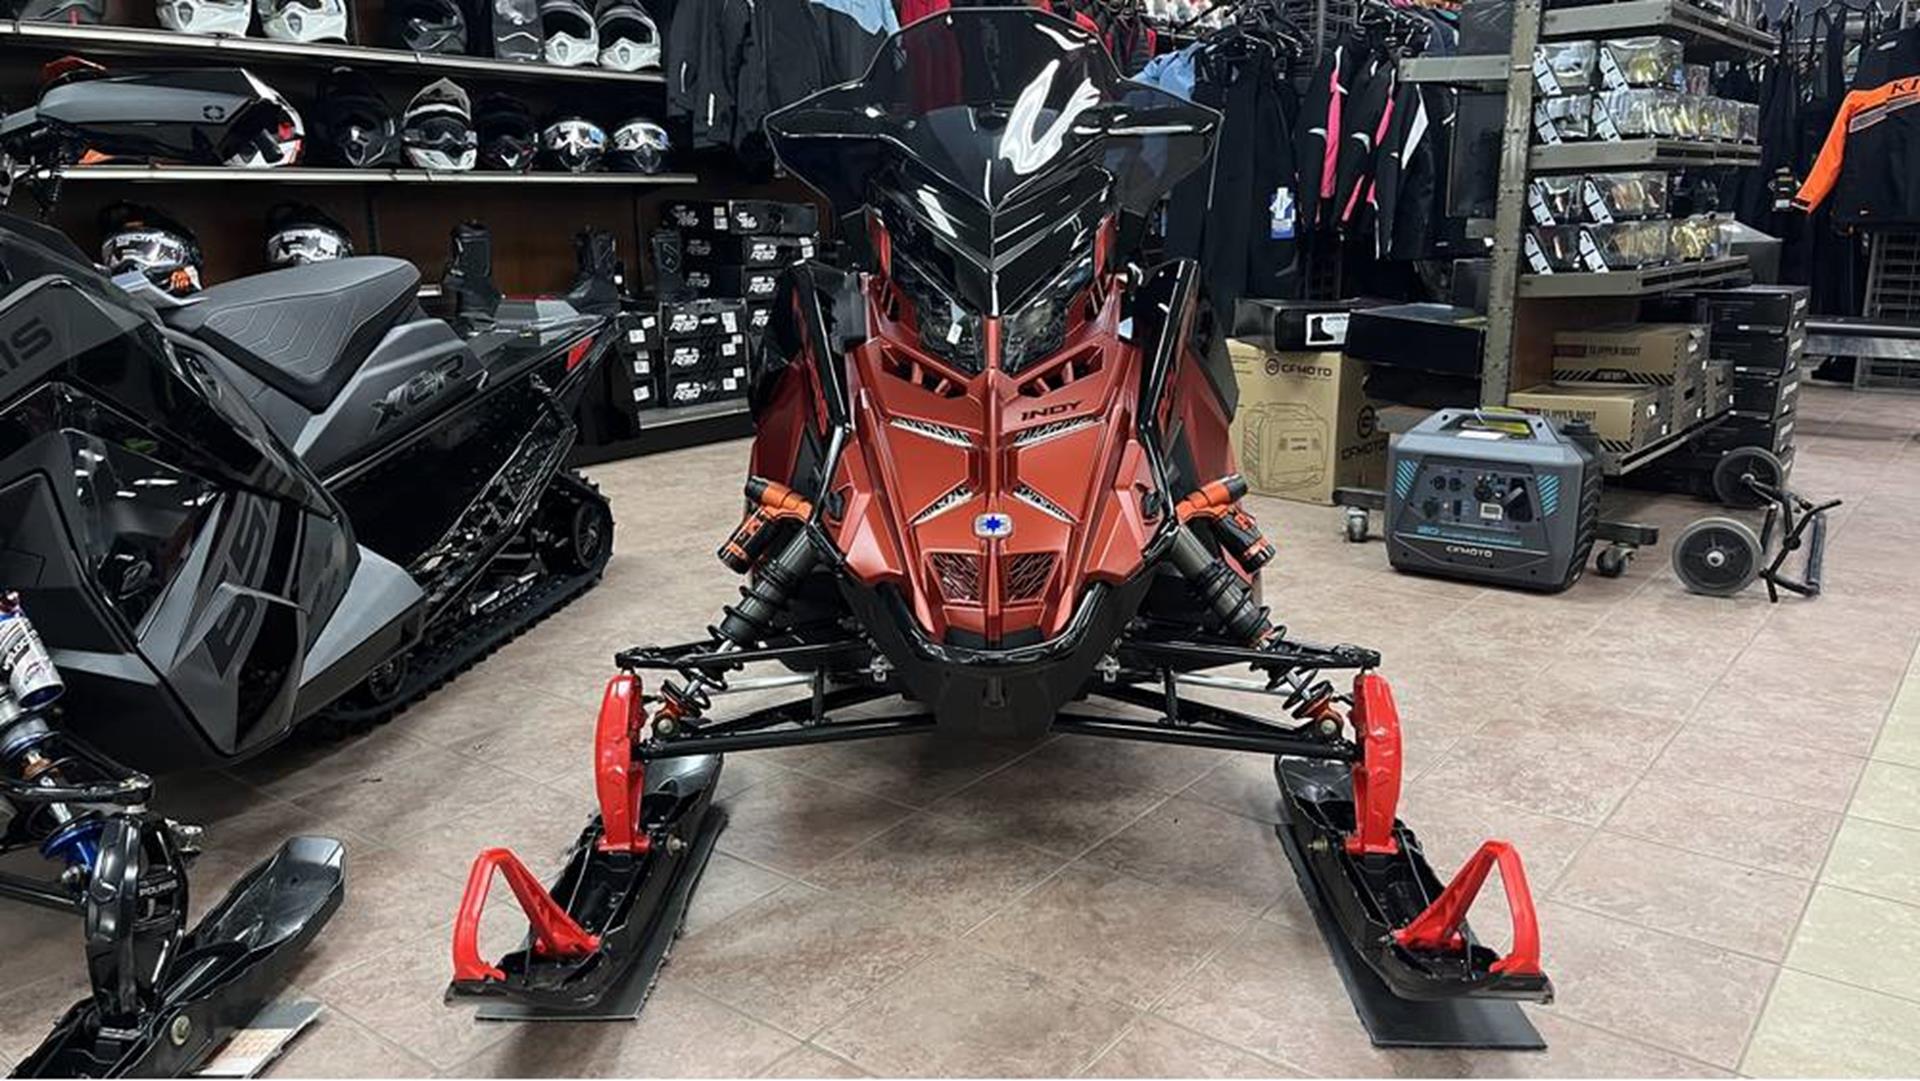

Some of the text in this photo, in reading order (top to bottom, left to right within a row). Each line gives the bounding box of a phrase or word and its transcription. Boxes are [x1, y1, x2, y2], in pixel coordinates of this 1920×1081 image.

[0, 317, 53, 378] IS
[1281, 362, 1333, 377] CFMOTO
[370, 352, 465, 432] XCR
[1020, 400, 1082, 422] INDY
[1446, 545, 1493, 558] CFMOTO
